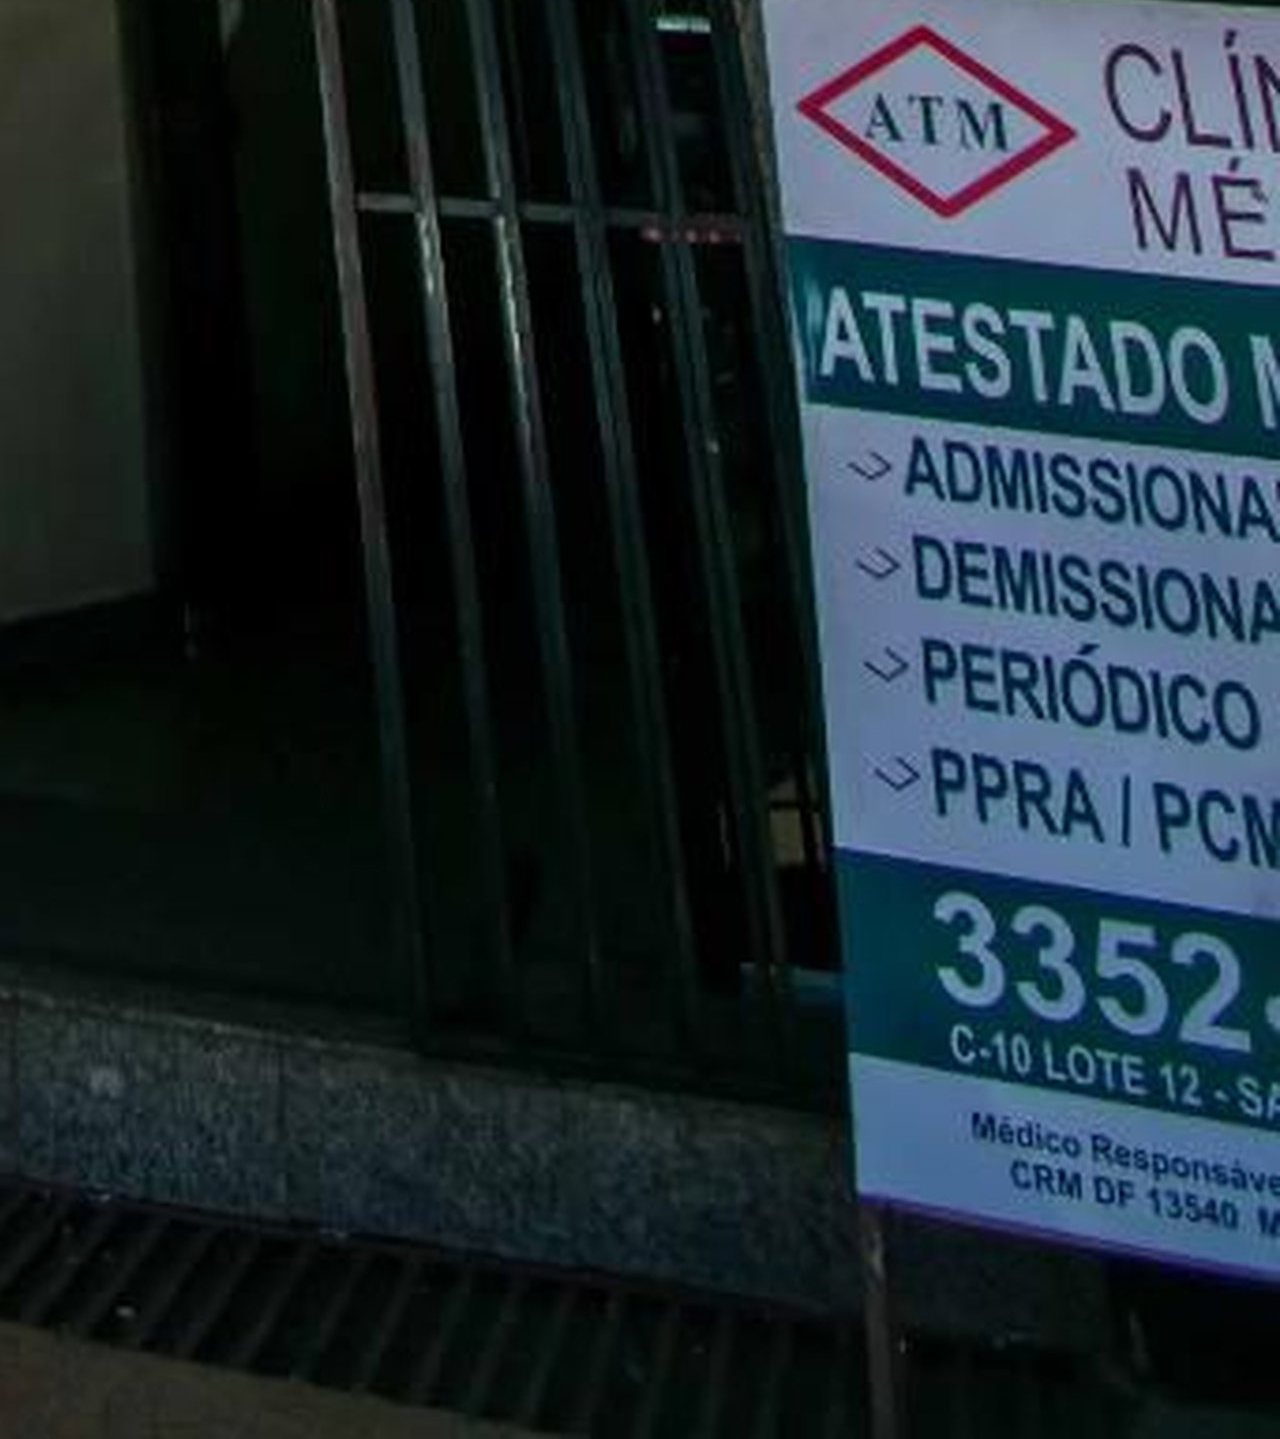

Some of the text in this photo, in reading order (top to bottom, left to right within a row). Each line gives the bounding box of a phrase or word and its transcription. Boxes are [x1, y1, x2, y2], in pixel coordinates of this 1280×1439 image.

[862, 91, 1012, 154] ATM
[818, 285, 1231, 427] ATESTADO
[919, 637, 1263, 752] PERIÓDICO
[931, 746, 1106, 846] PPRA
[949, 1023, 1032, 1076] C-10
[1042, 1037, 1147, 1097] LOTE
[1159, 1062, 1203, 1107] 12
[970, 1111, 1083, 1160] Médico
[1009, 1159, 1084, 1202] CRM
[1093, 1174, 1137, 1209] DF
[1147, 1186, 1240, 1231] 13540
